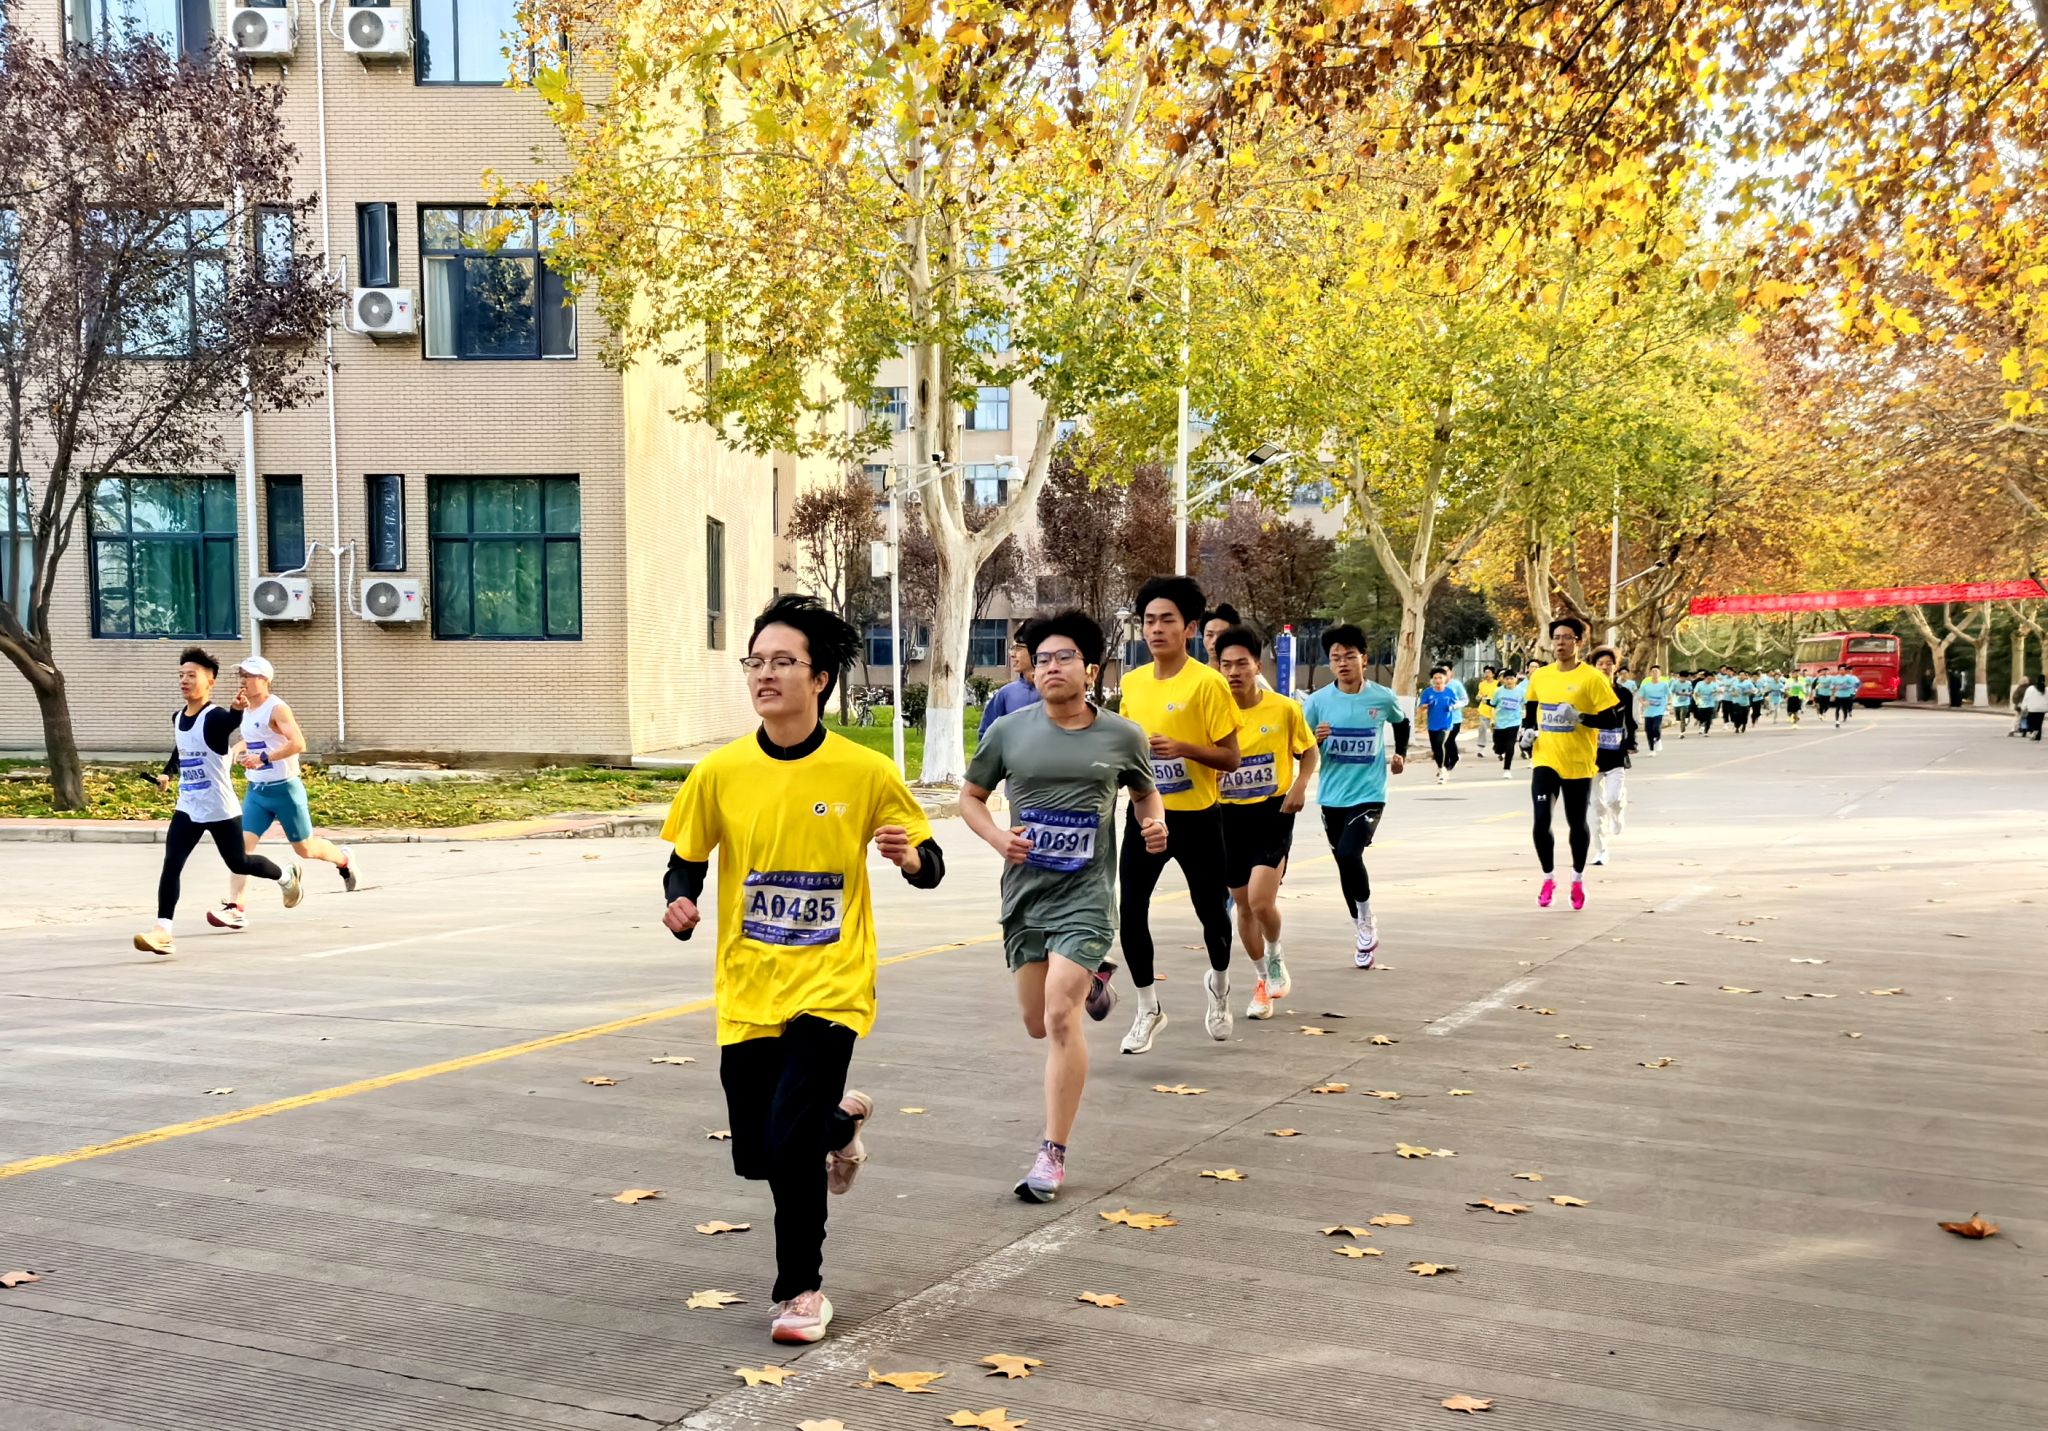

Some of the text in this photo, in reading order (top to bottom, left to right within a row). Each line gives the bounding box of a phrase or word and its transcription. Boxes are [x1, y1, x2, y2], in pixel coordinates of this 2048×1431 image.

[1330, 738, 1374, 752] A0797
[1151, 763, 1185, 780] 508
[1222, 767, 1273, 788] A0343
[1026, 827, 1091, 852] A0691
[750, 890, 836, 922] A0435
